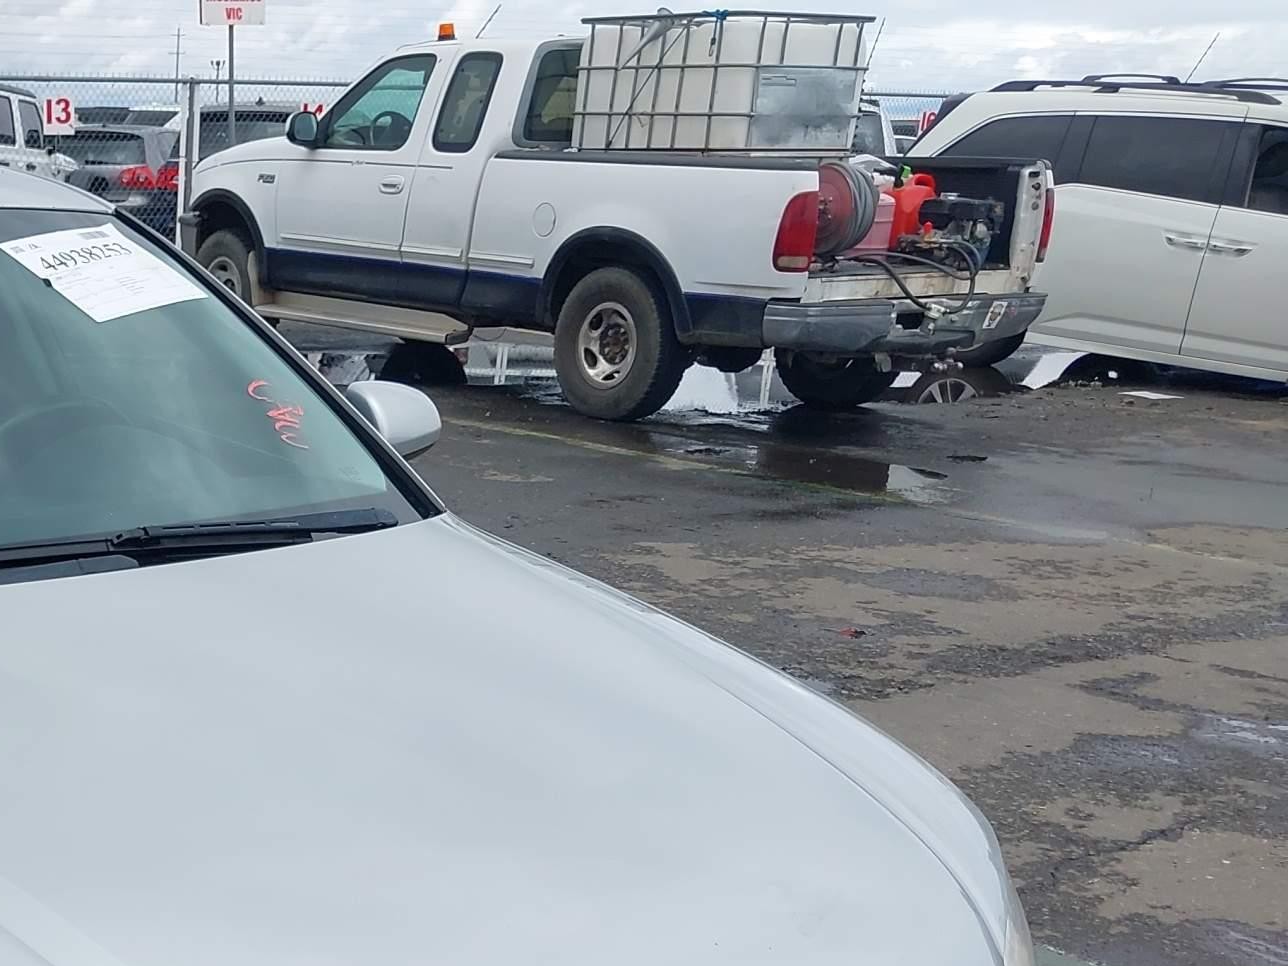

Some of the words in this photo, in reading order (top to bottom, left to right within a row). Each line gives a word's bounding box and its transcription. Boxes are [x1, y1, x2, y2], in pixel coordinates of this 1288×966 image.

[225, 7, 243, 20] VIC
[46, 98, 71, 124] 13
[39, 242, 133, 271] 44938253
